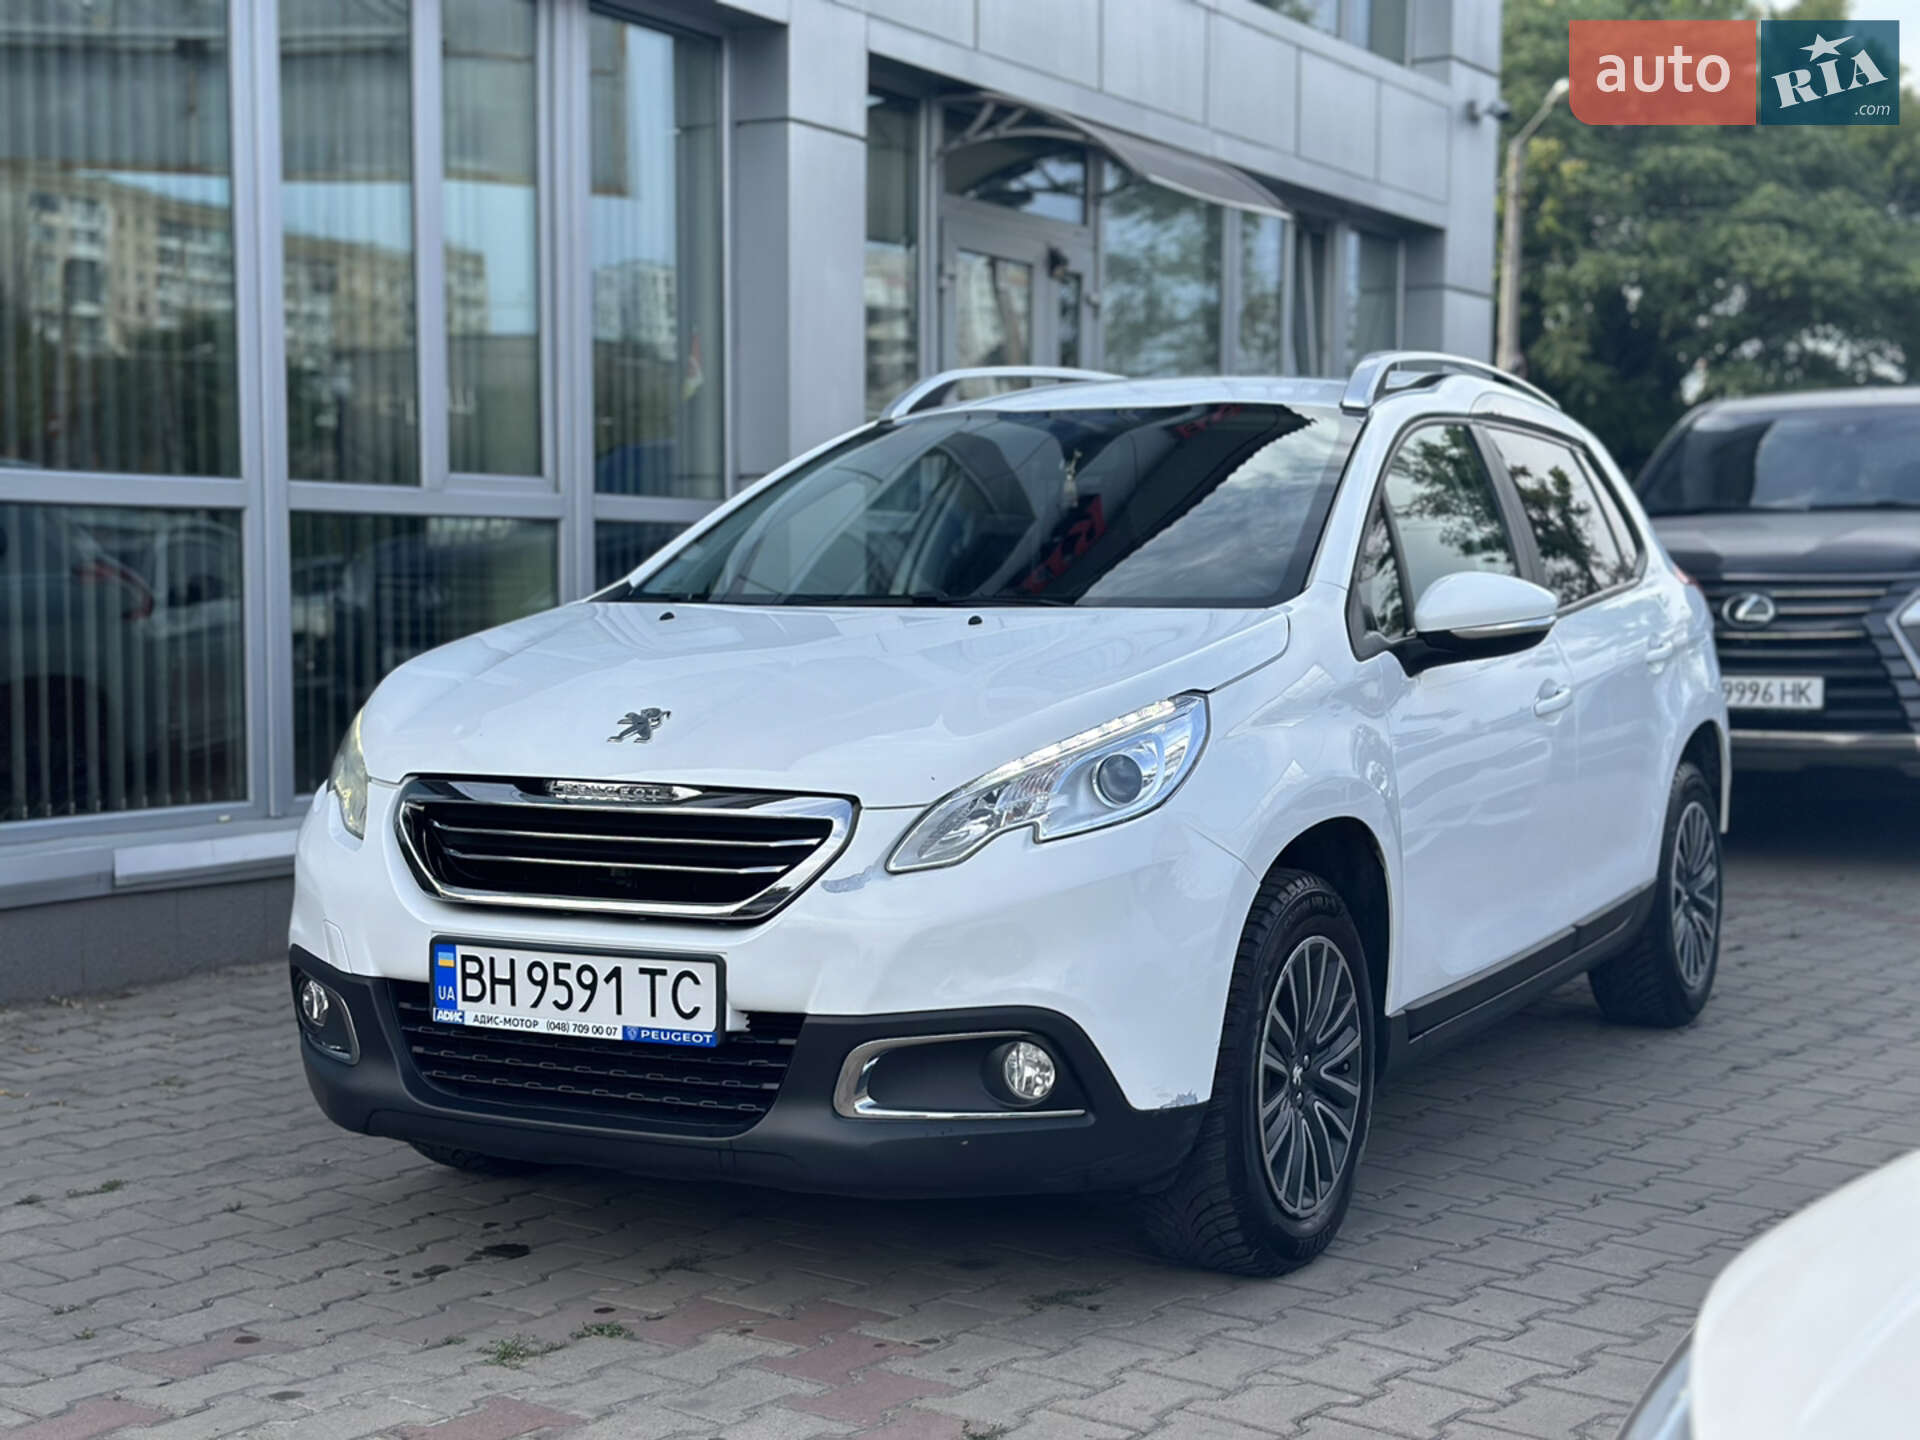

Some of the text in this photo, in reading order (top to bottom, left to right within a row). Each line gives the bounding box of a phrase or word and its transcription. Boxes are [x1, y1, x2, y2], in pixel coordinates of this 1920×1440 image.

[437, 985, 456, 1001] UA
[460, 953, 702, 1021] BH 9591 TC
[546, 1020, 570, 1033] (048)
[572, 1023, 590, 1034] 709
[591, 1025, 605, 1036] 00
[605, 1026, 619, 1037] 07
[640, 1029, 713, 1044] PEUGEOT
